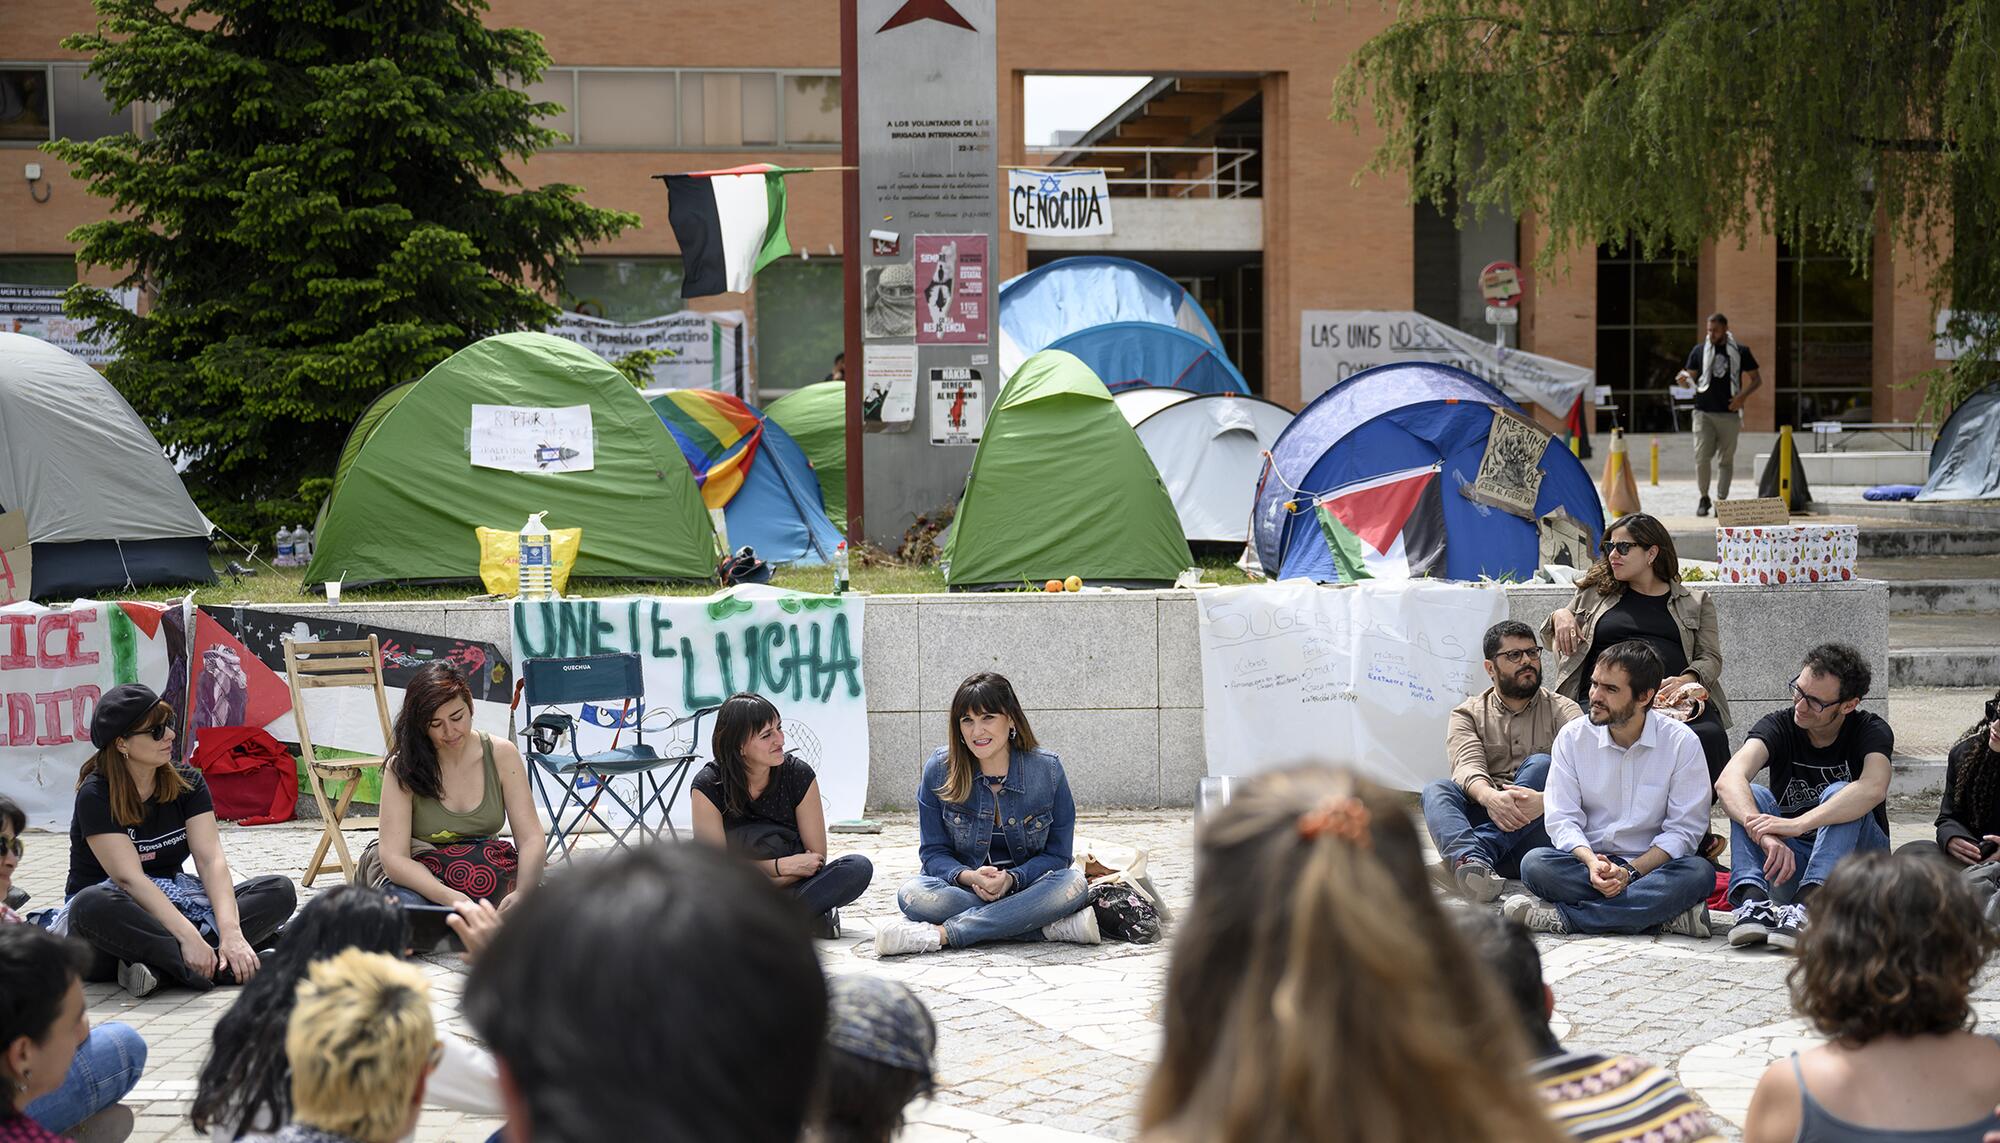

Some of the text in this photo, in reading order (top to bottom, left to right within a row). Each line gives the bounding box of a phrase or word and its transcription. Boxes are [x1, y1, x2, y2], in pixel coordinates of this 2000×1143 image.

[1013, 185, 1103, 229] GENOCIDA
[1, 288, 16, 297] UCM
[17, 289, 22, 297] Y
[23, 289, 31, 297] EL
[580, 332, 592, 343] el
[596, 332, 641, 345] pueblo
[646, 329, 709, 345] palestino
[923, 322, 967, 332] RESISTENCIA
[1311, 324, 1340, 348] LAS
[1347, 324, 1381, 349] UNIS
[1389, 321, 1411, 349] NO
[942, 369, 971, 380] NAKBA
[937, 392, 945, 400] AL
[1496, 414, 1547, 451] PALESTINA
[1496, 487, 1504, 497] AL
[1504, 489, 1523, 501] FUEGO
[0, 607, 100, 671] ICE
[1207, 603, 1467, 660] SUGERENCIAS
[680, 612, 862, 710] LUCHA
[0, 684, 102, 748] DIO
[139, 842, 163, 852] Expresa
